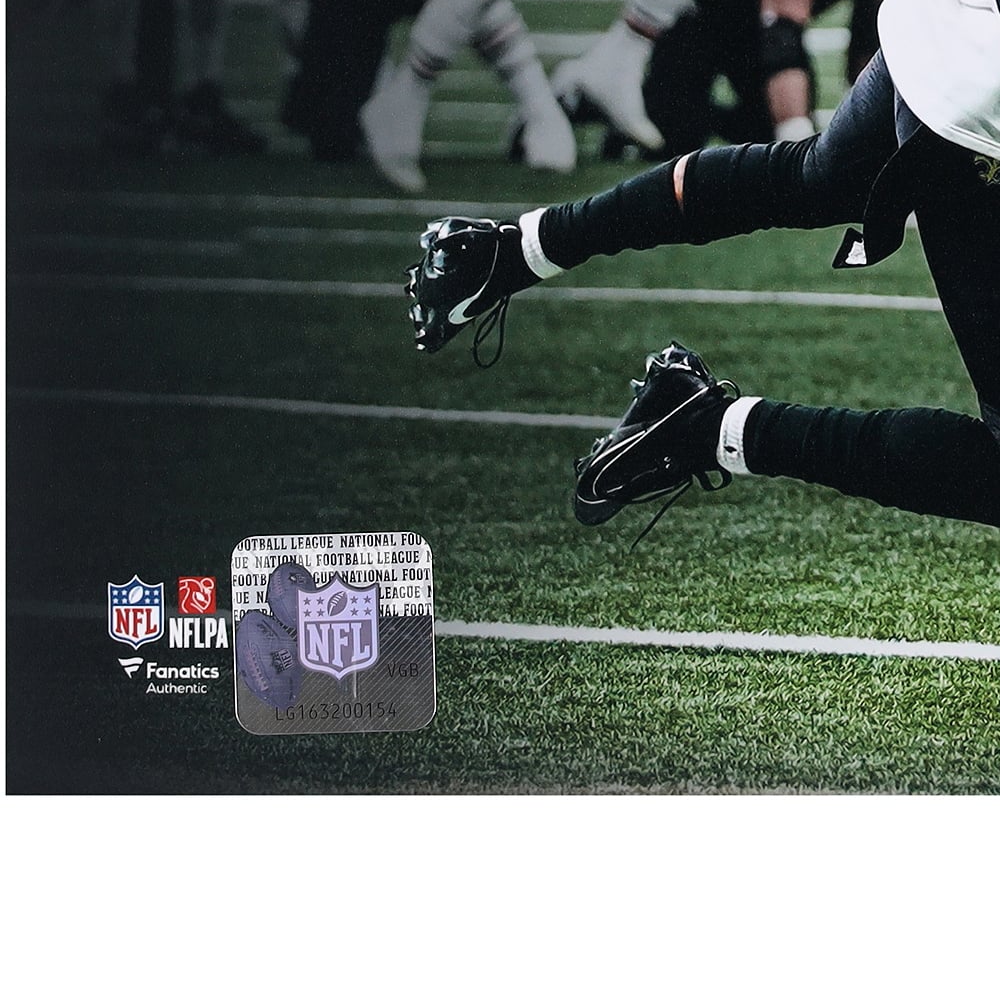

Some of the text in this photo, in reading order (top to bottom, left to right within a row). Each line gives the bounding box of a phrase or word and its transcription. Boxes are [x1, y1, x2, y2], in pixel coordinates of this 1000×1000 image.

[291, 536, 333, 549] LEAGUE
[340, 534, 396, 548] NATIONAL
[401, 533, 427, 545] FOO
[317, 552, 373, 566] FOOTBALL
[377, 551, 419, 564] LEAGUE
[342, 569, 397, 582] NATIONAL
[402, 568, 430, 581] FOOT
[379, 586, 420, 599] LEAGUE
[403, 603, 432, 616] FOOT
[115, 608, 157, 638] NFL
[169, 618, 229, 648] NFLPA
[306, 622, 370, 668] NFL
[146, 662, 219, 679] Fanatics
[387, 662, 419, 678] VGB
[146, 682, 208, 694] Authentic
[275, 702, 397, 720] LG163200154
